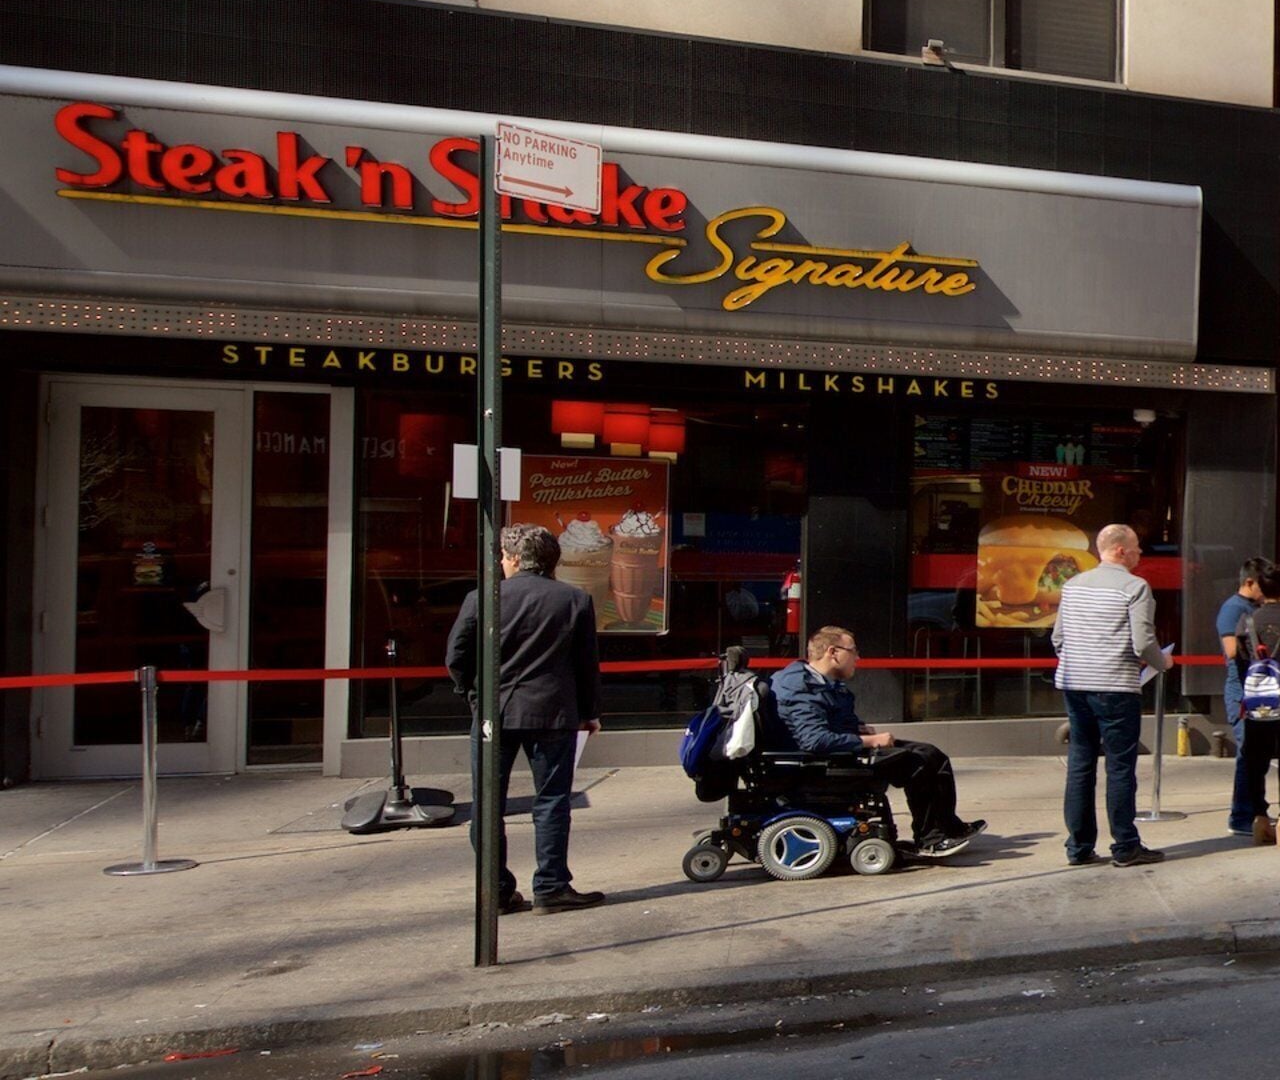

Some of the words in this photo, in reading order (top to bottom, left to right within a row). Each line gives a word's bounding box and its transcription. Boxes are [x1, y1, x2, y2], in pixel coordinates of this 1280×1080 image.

[55, 102, 333, 205] Steak
[503, 131, 520, 145] NO
[524, 136, 578, 160] PARKING
[503, 147, 555, 170] Anytime
[646, 206, 978, 310] Signature
[222, 344, 604, 381] STEAKBURGERS
[745, 370, 999, 399] MILKSHAKES
[551, 459, 578, 469] New!
[1029, 465, 1068, 477] NEW!
[529, 471, 592, 488] Peanut
[595, 468, 652, 483] Butter
[1002, 475, 1095, 499] CHEDDAR
[532, 483, 633, 505] Milkshakes
[1016, 491, 1082, 515] Cheesy
